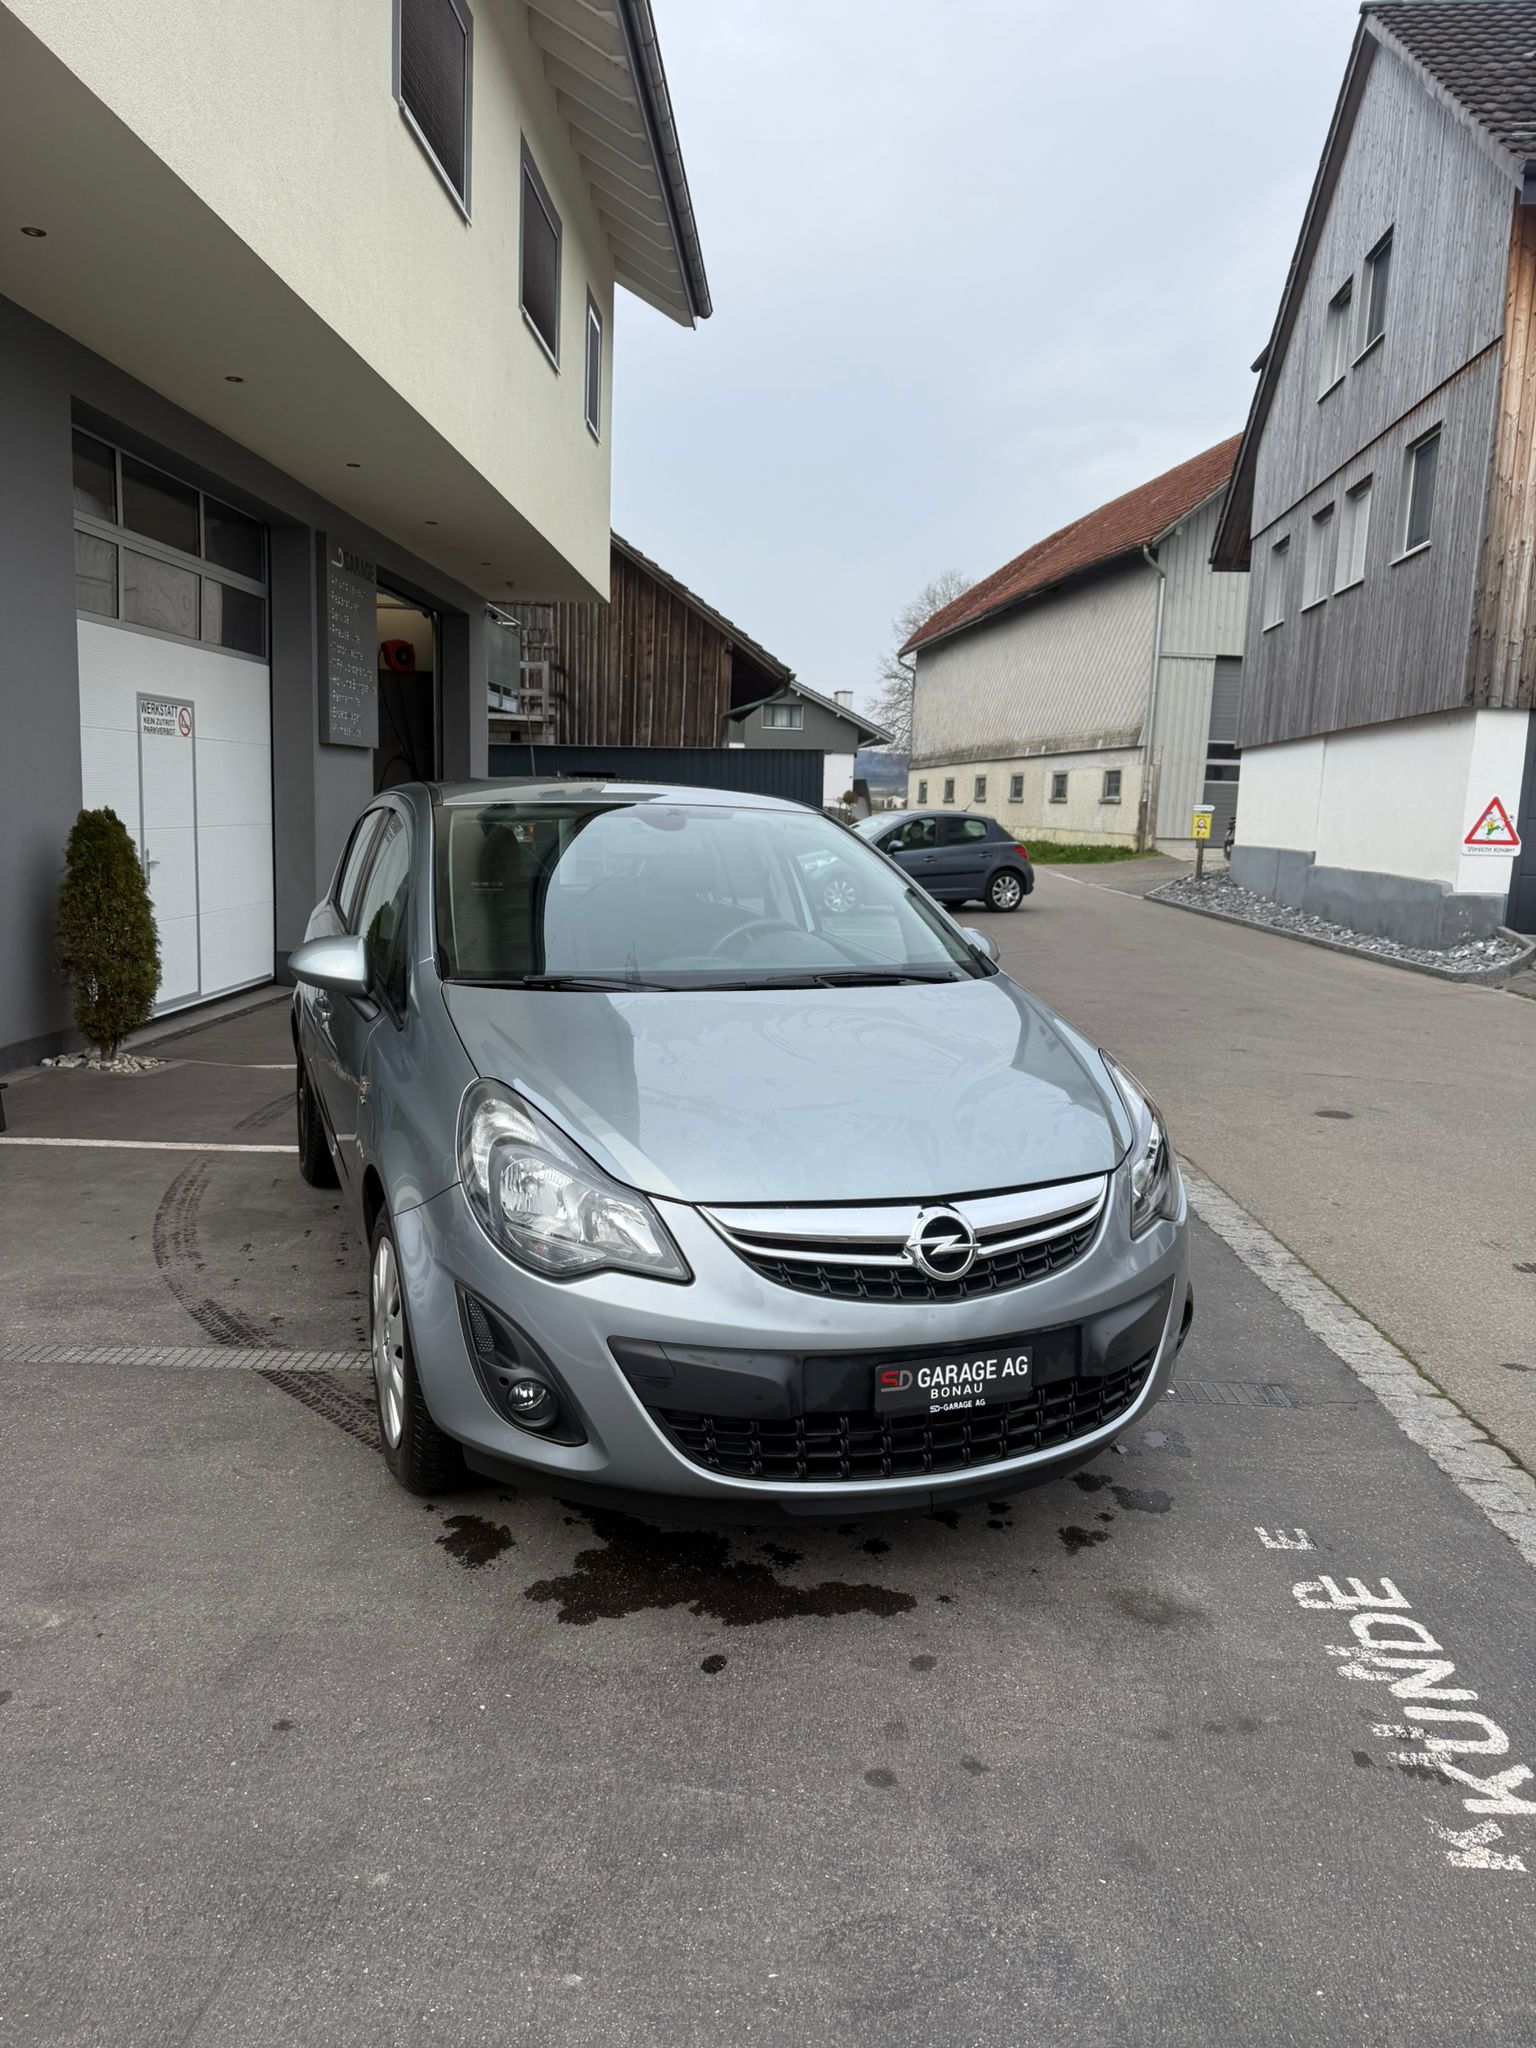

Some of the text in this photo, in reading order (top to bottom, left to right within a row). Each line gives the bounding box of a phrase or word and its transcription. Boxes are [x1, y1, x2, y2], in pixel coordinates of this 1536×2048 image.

[344, 551, 374, 584] GARAGE
[140, 702, 177, 718] WERKSTATT
[143, 717, 175, 727] KEIN ZUTRITT
[143, 726, 175, 735] PARKVERBOT
[917, 1358, 998, 1389] GARAGE
[1001, 1355, 1029, 1379] AG
[930, 1382, 984, 1399] BONAU
[929, 1398, 986, 1413] SD-GARAGE AG
[1318, 1575, 1536, 1815] KUNDE
